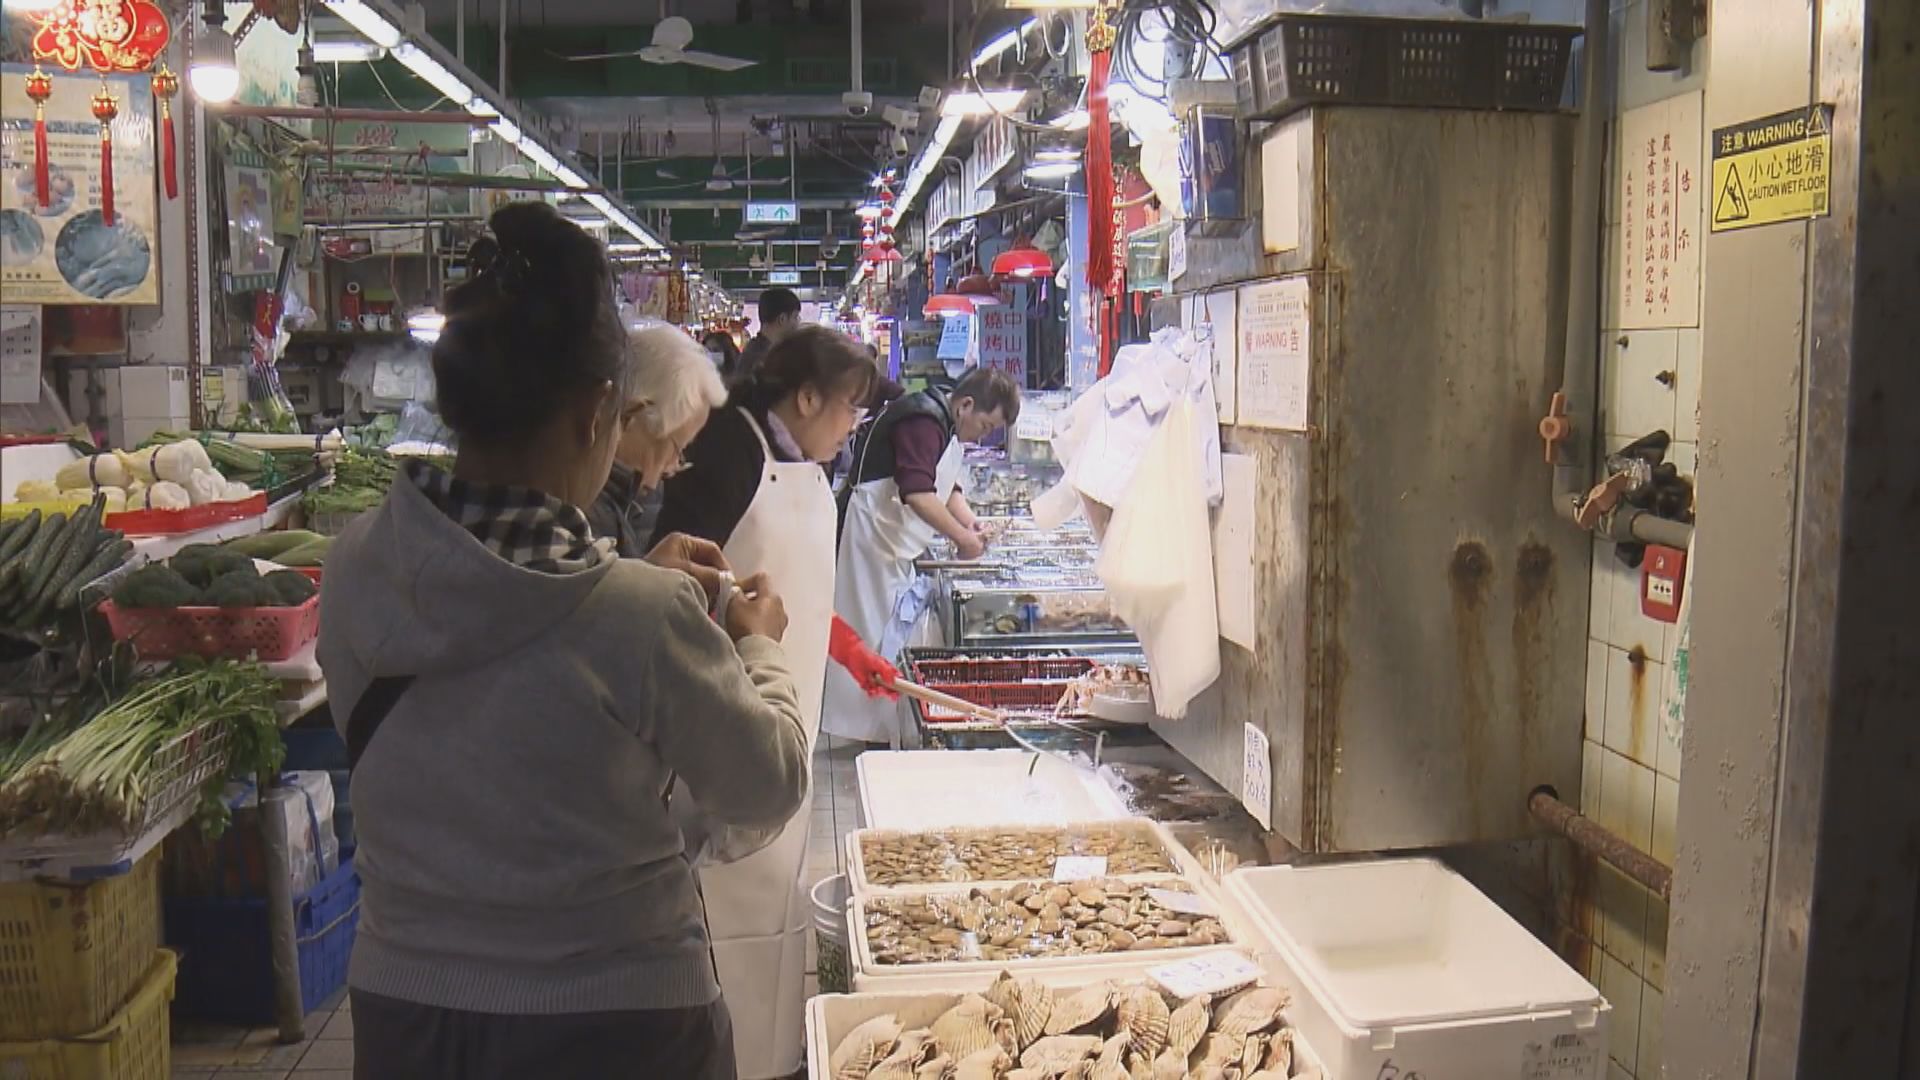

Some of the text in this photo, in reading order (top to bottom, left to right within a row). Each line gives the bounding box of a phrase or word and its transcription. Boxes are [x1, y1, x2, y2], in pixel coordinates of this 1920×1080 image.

[1721, 118, 1804, 153] 注意 WARNING
[1748, 144, 1824, 185] 小心地滑
[1747, 175, 1826, 201] CAUTION WET FLOOR
[1255, 331, 1288, 350] WARNING
